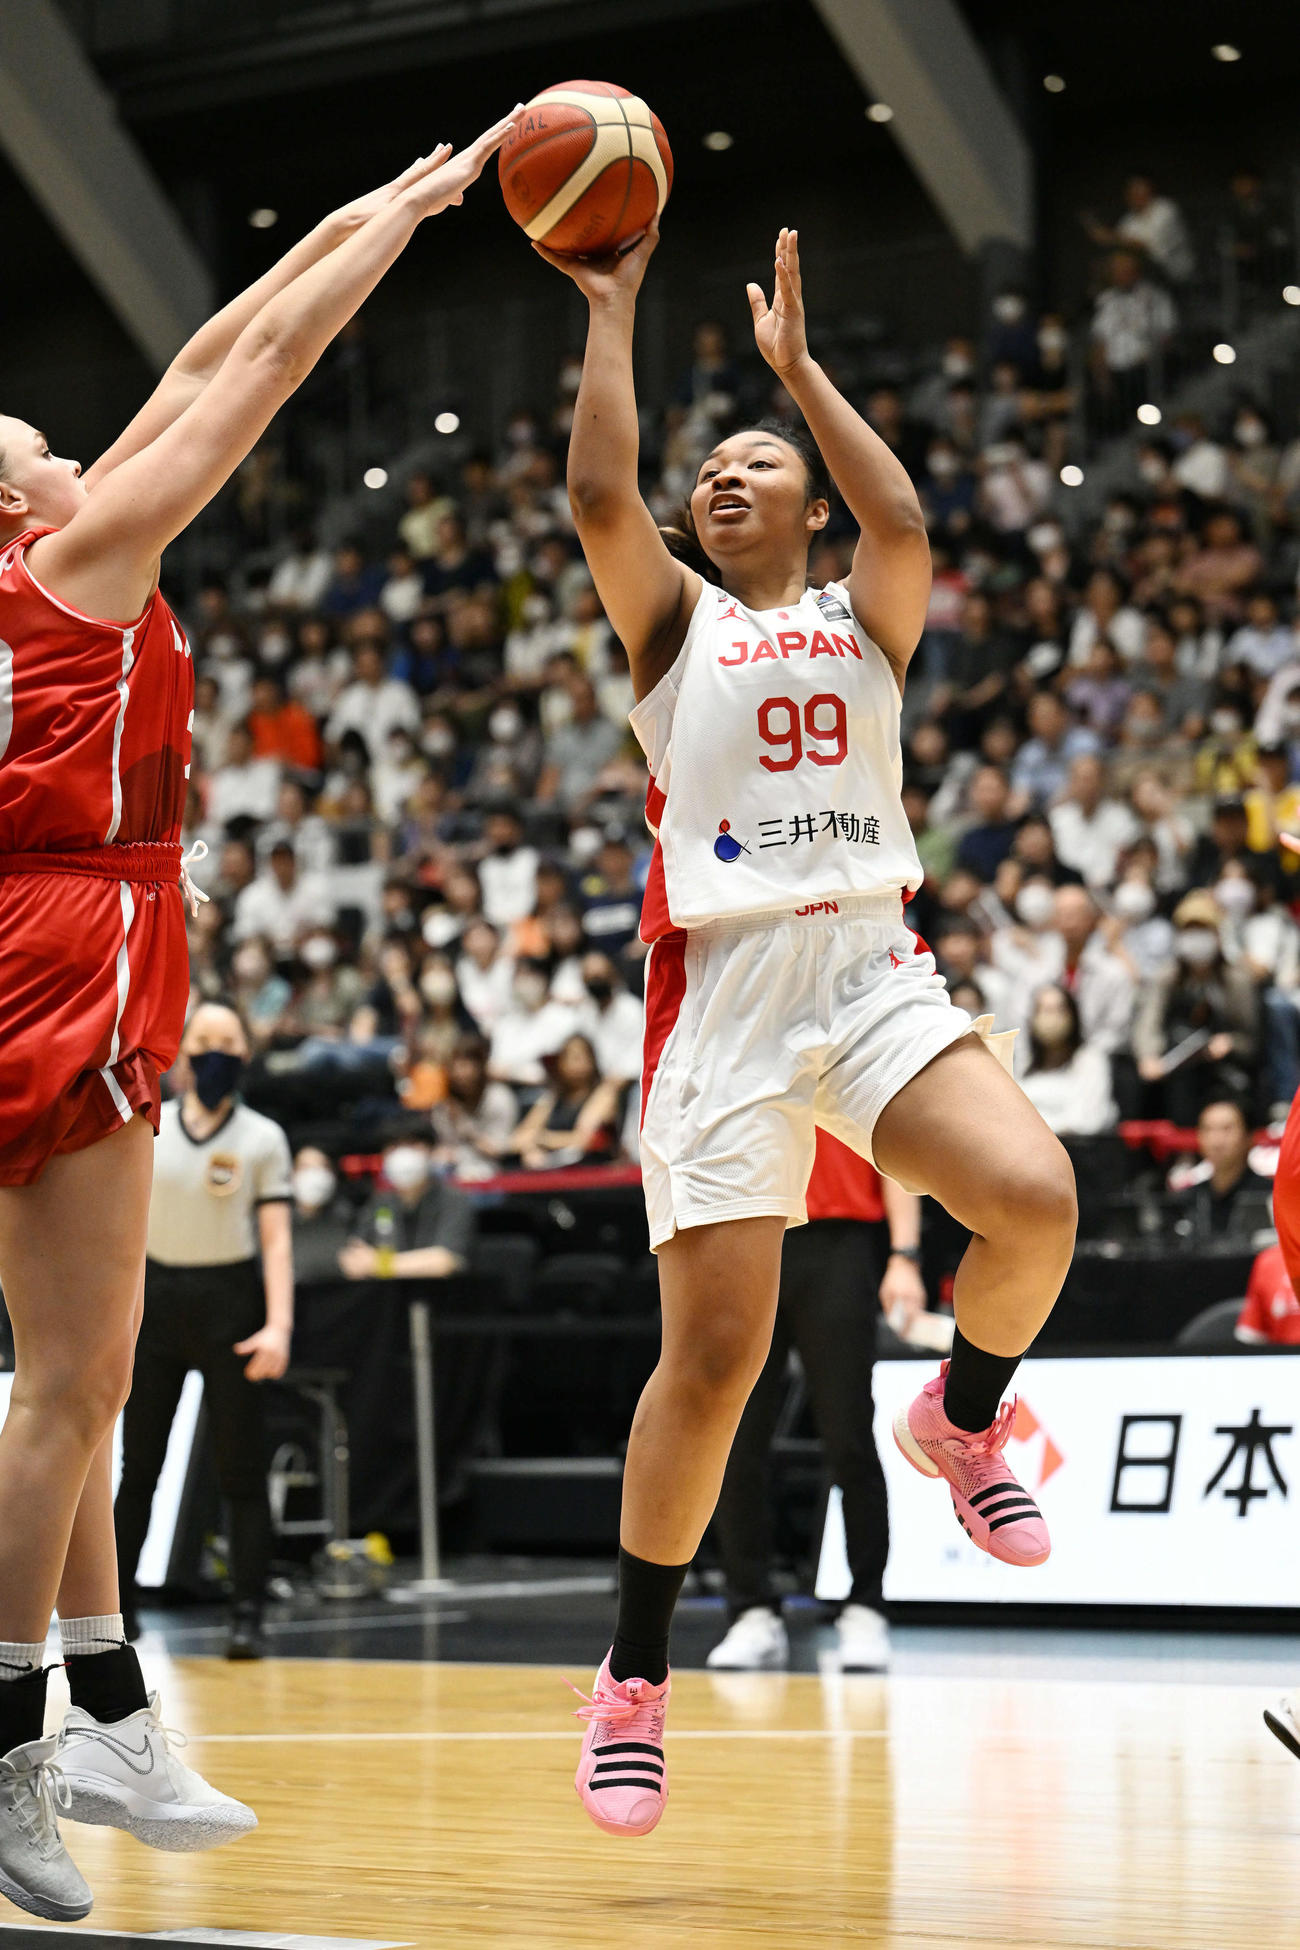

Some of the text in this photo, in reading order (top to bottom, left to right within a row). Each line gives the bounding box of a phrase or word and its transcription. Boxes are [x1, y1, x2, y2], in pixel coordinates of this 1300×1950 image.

[718, 630, 863, 667] JAPAN
[757, 693, 848, 773] 99
[758, 810, 881, 849] 三井不動産
[795, 900, 839, 917] JPN
[1109, 1409, 1293, 1517] 日本
